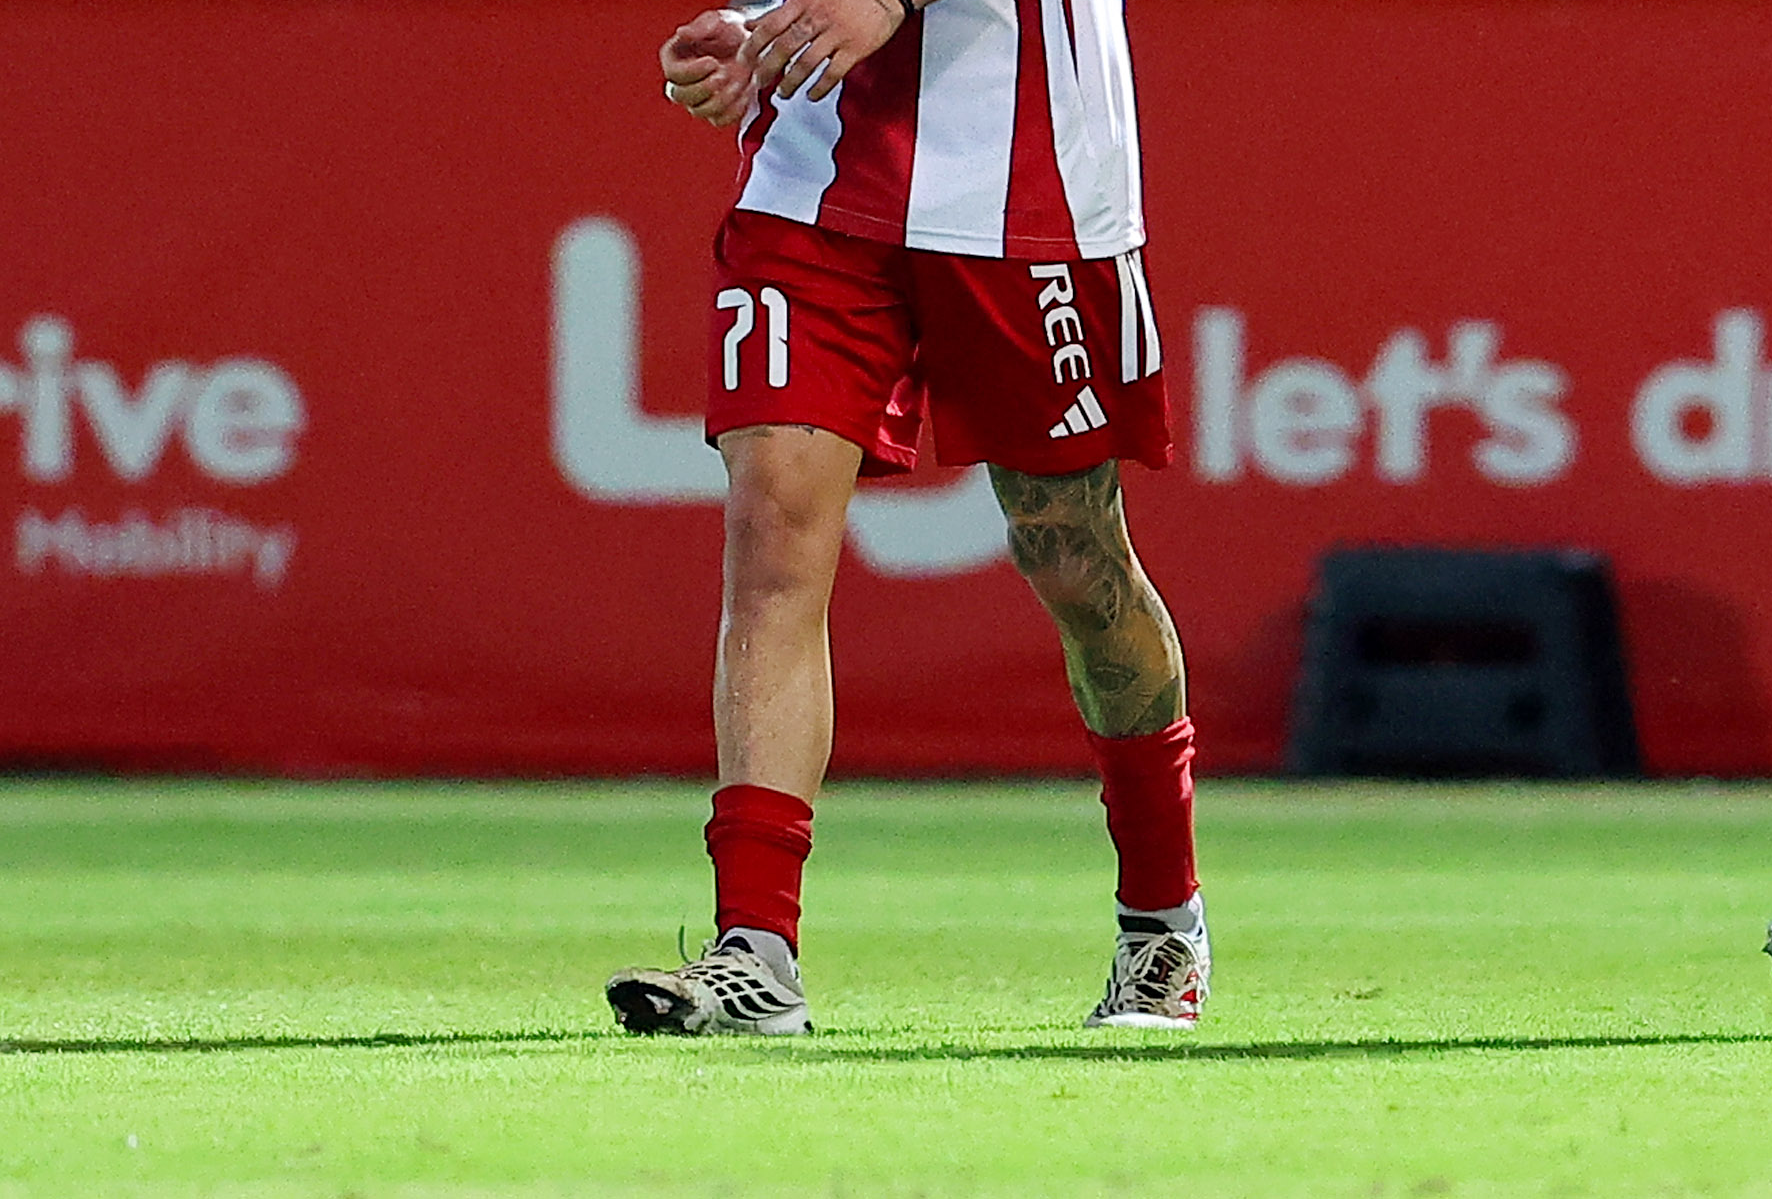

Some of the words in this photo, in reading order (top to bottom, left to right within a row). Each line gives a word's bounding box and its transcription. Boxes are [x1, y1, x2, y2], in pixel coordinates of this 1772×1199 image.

[0, 316, 306, 484] ive
[716, 287, 788, 390] 71
[1193, 307, 1576, 485] let's
